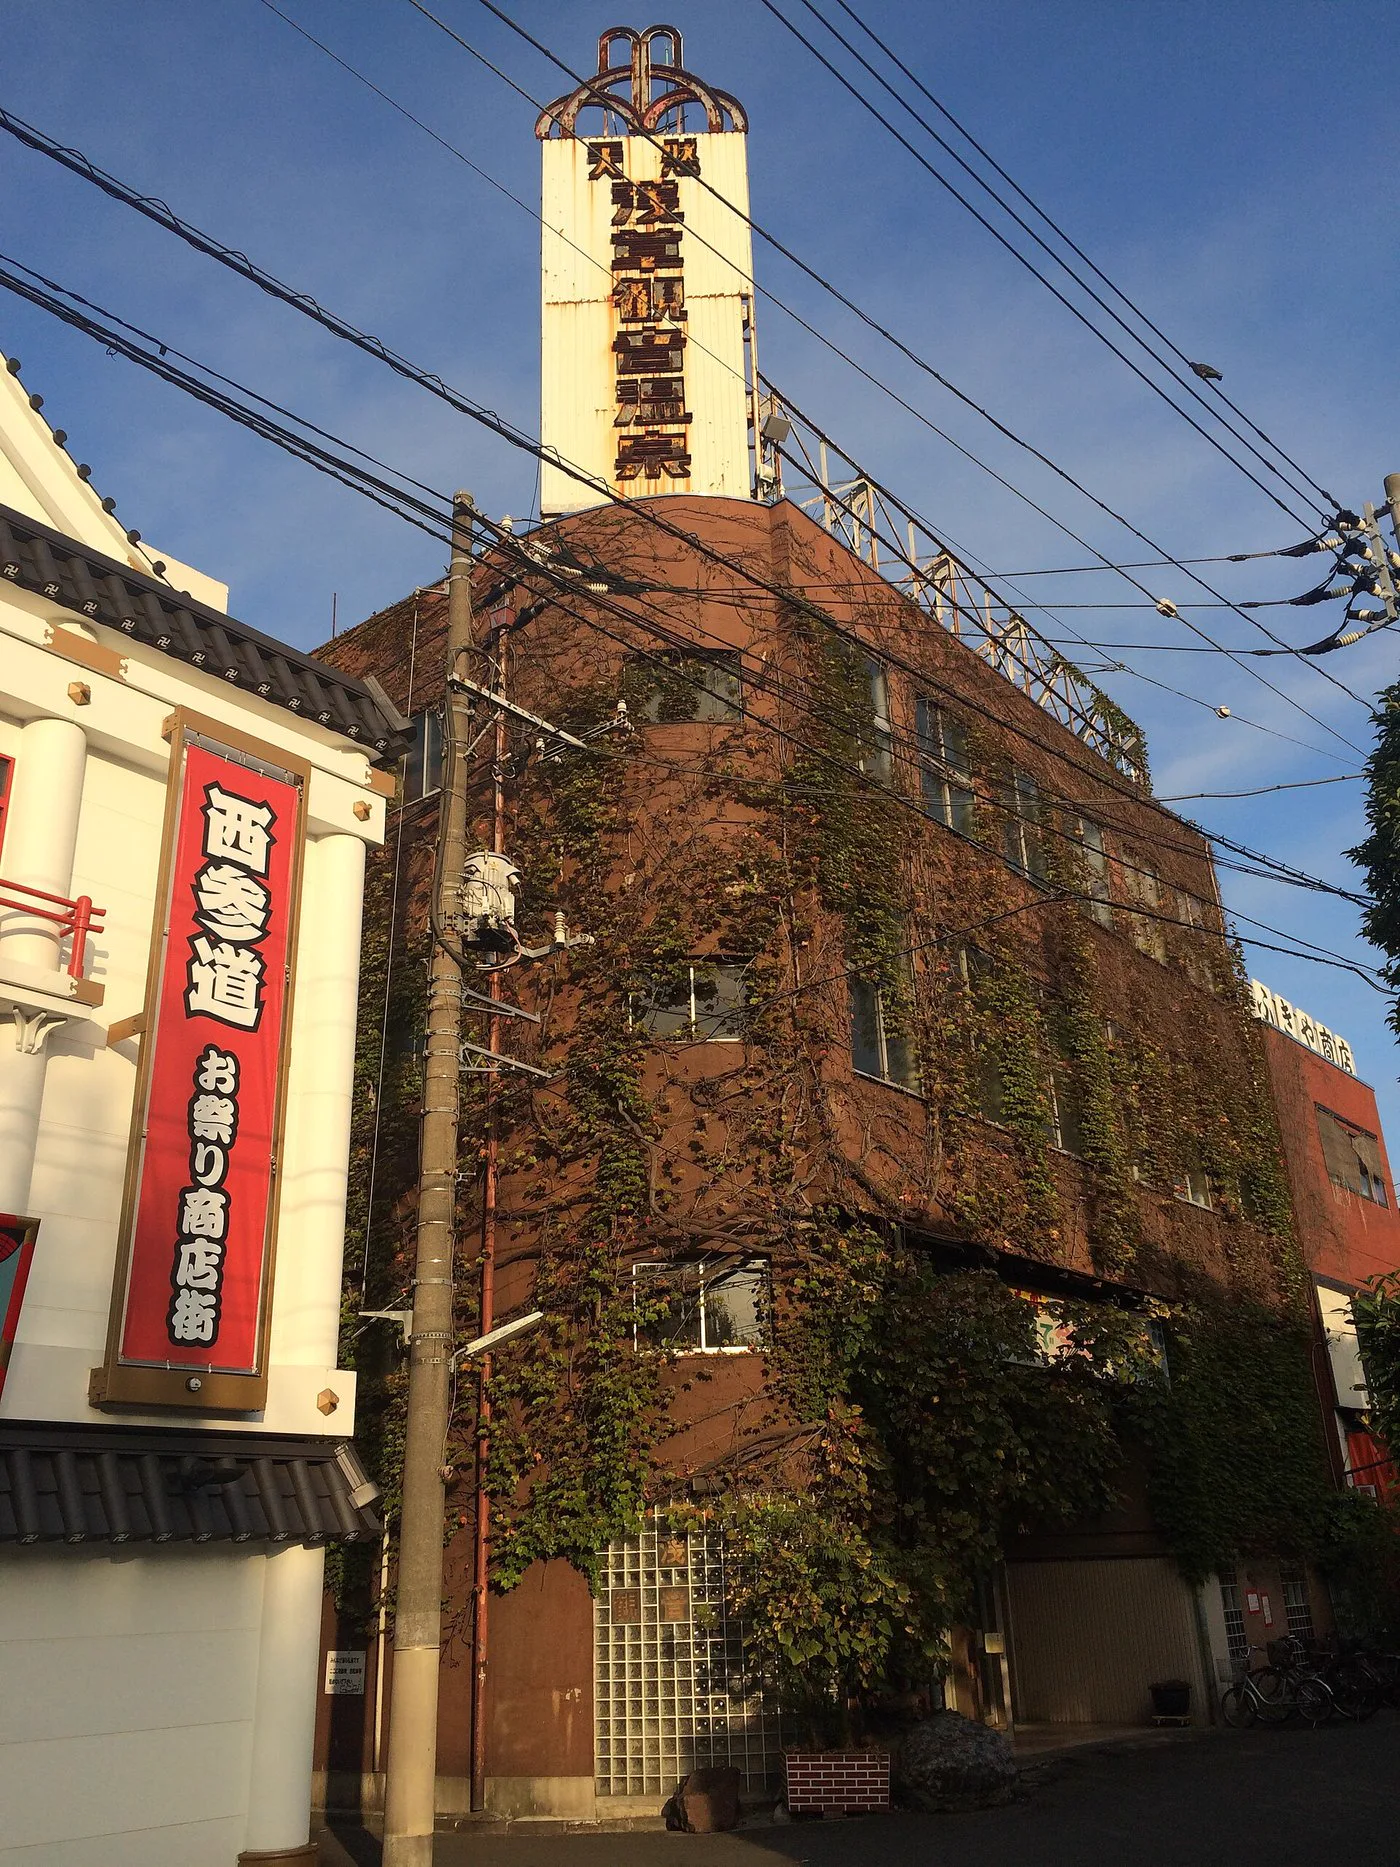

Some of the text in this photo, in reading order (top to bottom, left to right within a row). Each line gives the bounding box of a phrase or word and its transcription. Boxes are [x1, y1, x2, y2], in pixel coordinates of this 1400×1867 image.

[186, 784, 276, 1030] 西参道
[170, 1047, 239, 1343] お祭り商店街
